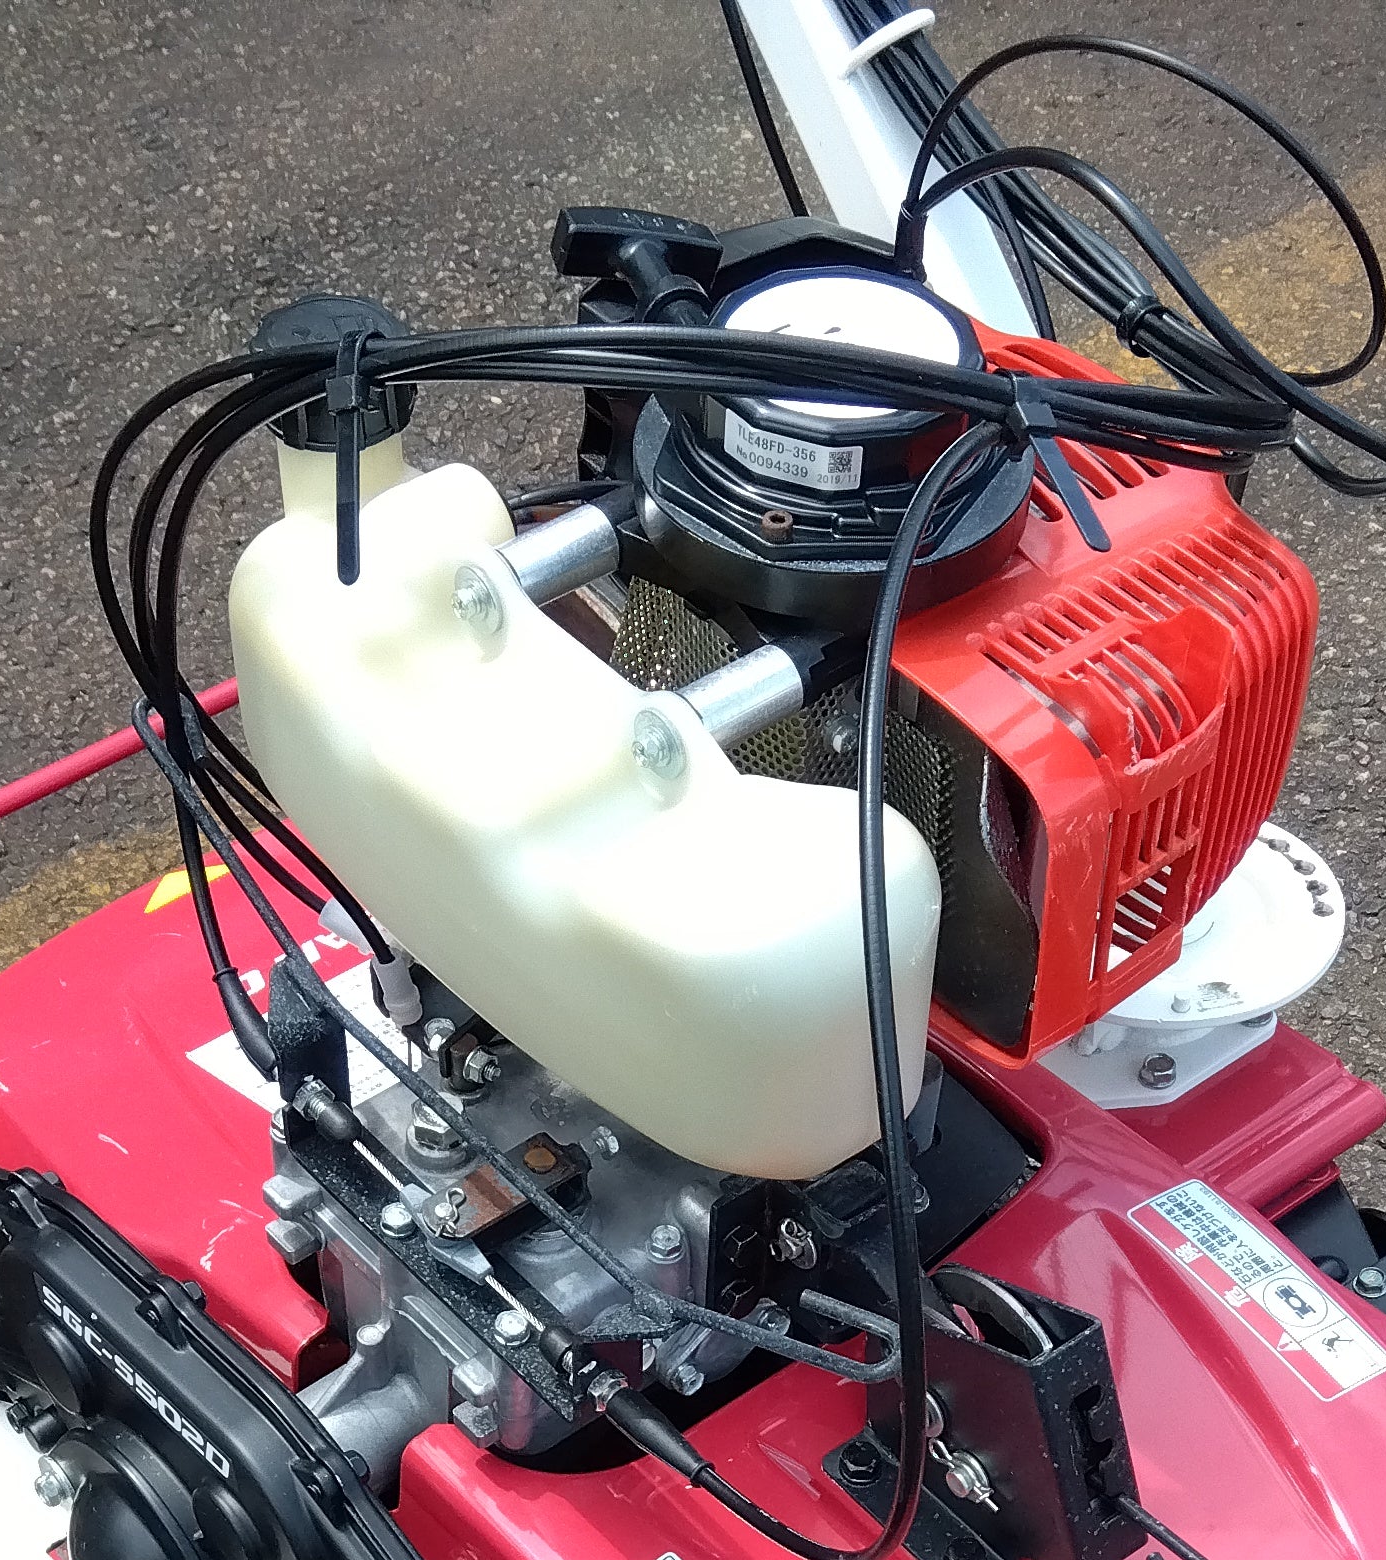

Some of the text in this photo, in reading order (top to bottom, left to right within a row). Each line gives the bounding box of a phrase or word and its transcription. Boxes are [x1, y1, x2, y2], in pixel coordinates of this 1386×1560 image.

[737, 424, 816, 462] TLE48FD-356
[817, 473, 857, 484] 2019/11
[42, 1285, 230, 1479] SGC-S502D
